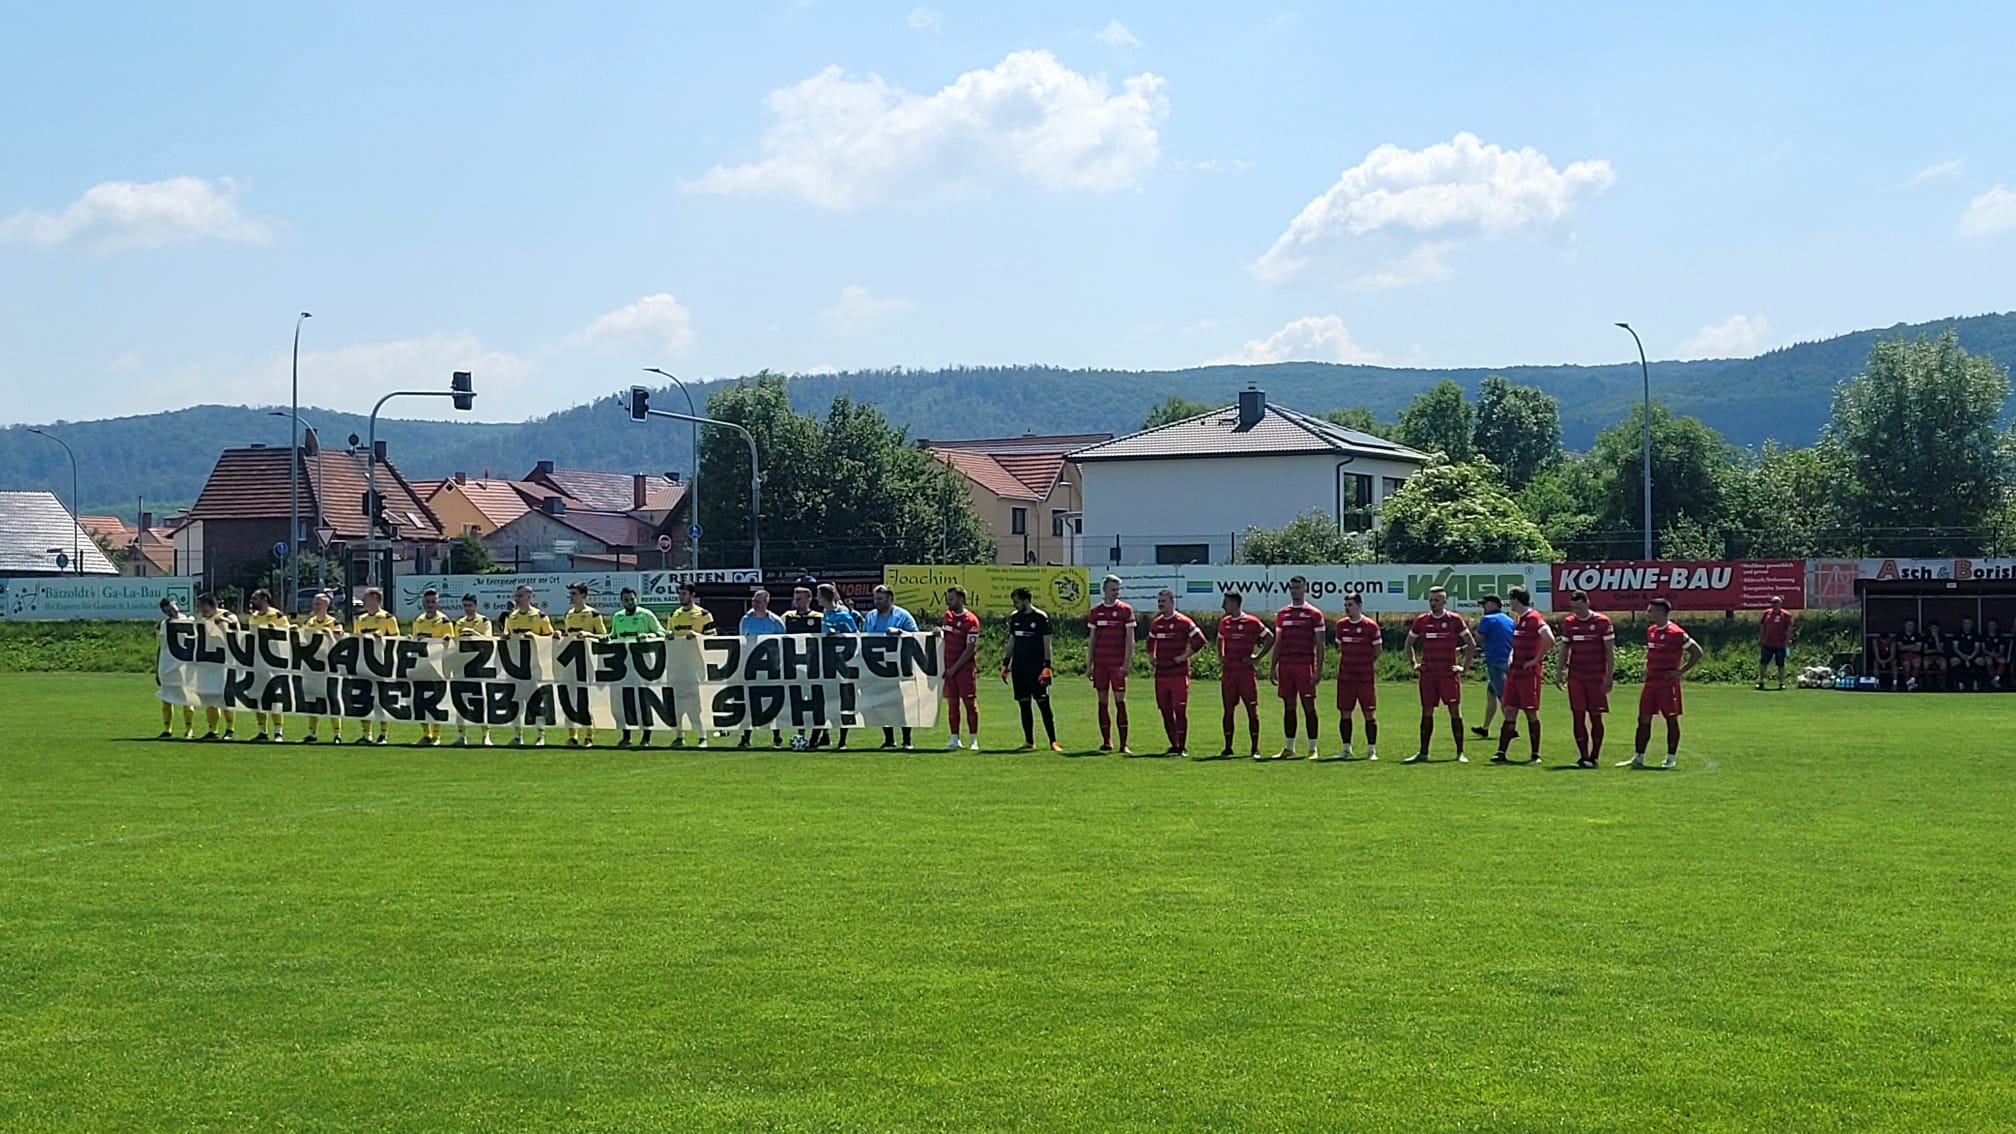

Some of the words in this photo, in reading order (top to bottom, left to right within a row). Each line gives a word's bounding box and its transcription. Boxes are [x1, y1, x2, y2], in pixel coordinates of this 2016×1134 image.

[668, 571, 726, 584] REIFEN
[888, 568, 958, 586] Joachim
[1558, 564, 1733, 591] KÖHNE-BAU
[1876, 559, 1932, 580] Asch
[102, 586, 161, 599] Ga-La-Bau
[1408, 567, 1524, 600] WAGO
[167, 622, 430, 678] GLÜCKAUF
[458, 639, 532, 680] ZU
[556, 639, 667, 682] 130
[703, 634, 939, 682] JAHREN
[224, 668, 593, 726] KALIBERGBAU
[622, 686, 678, 728] IN
